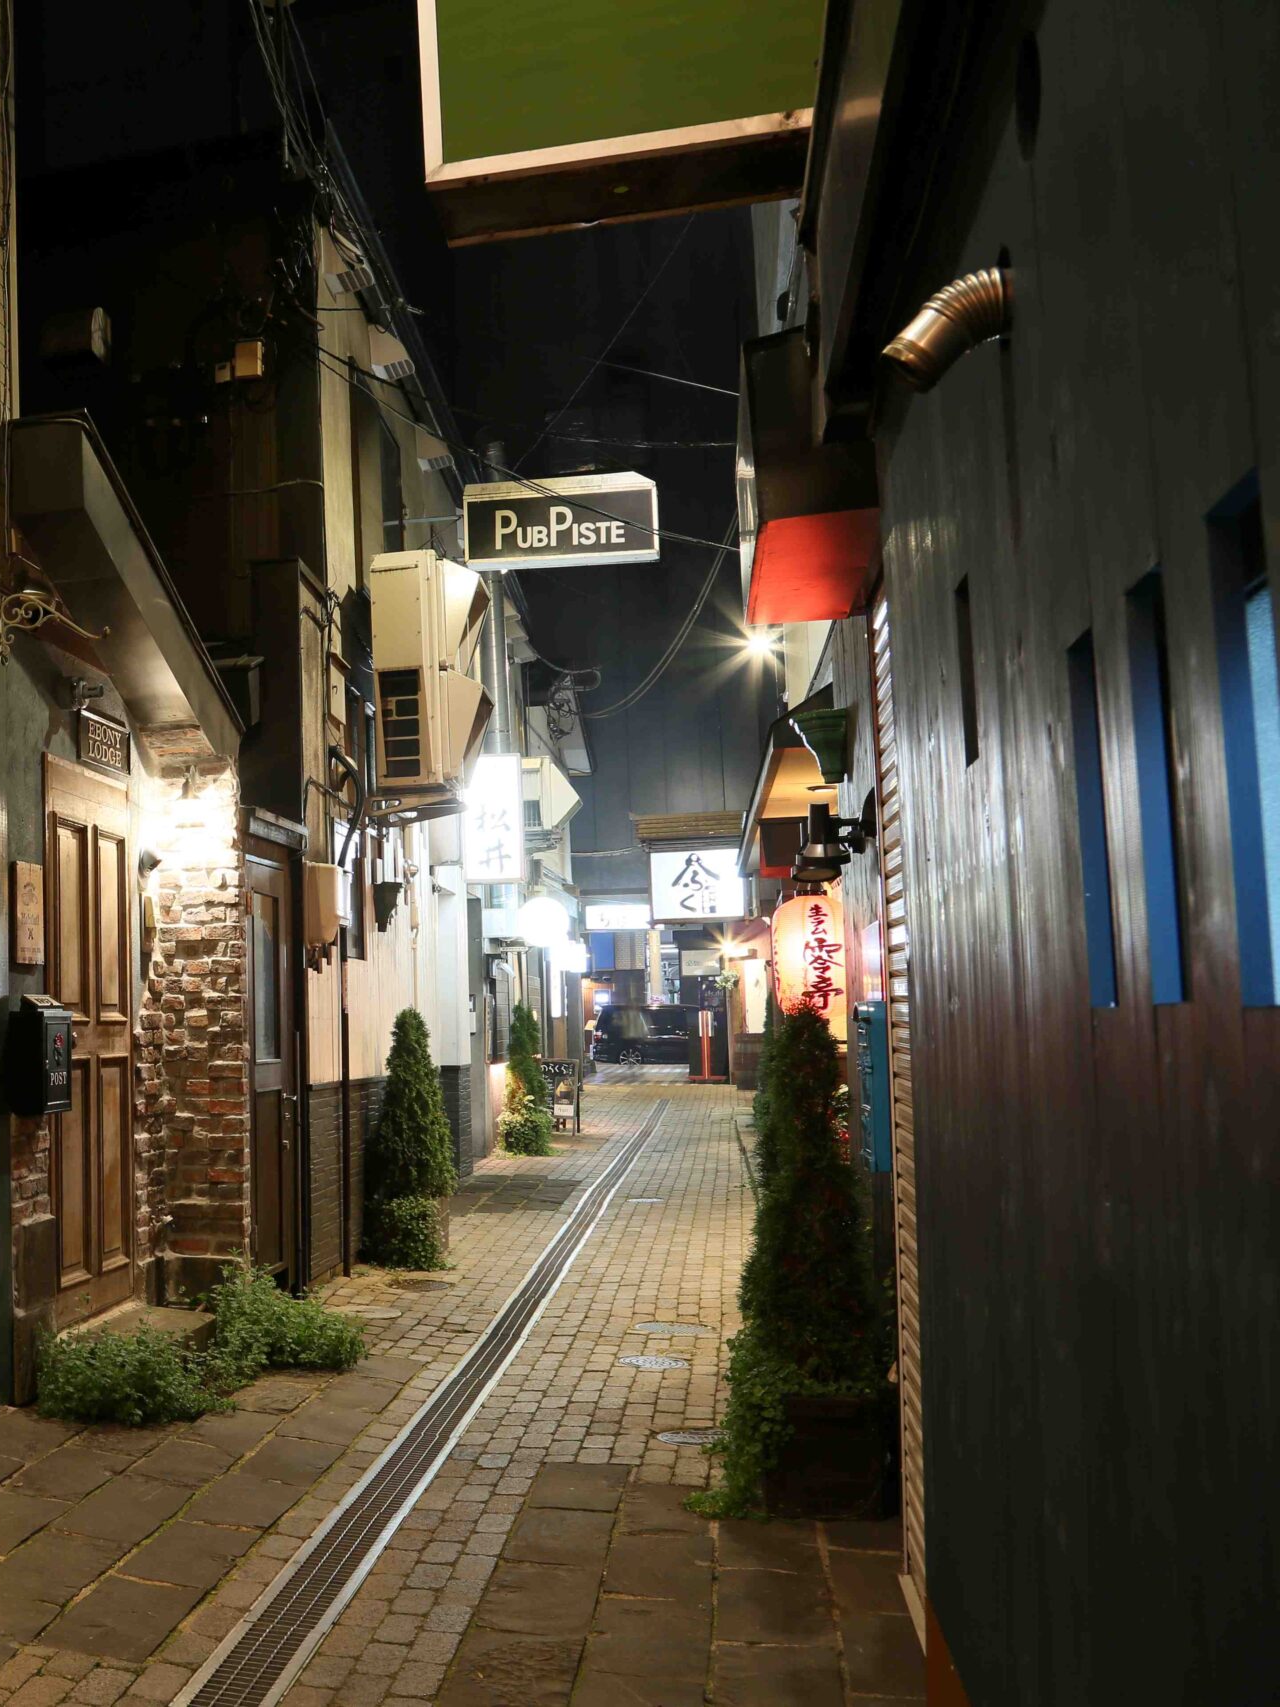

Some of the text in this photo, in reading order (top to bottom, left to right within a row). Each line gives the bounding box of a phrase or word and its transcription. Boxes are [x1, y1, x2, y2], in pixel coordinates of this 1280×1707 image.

[88, 720, 122, 748] EBONY
[88, 740, 122, 768] LODGE
[50, 1071, 67, 1085] POST
